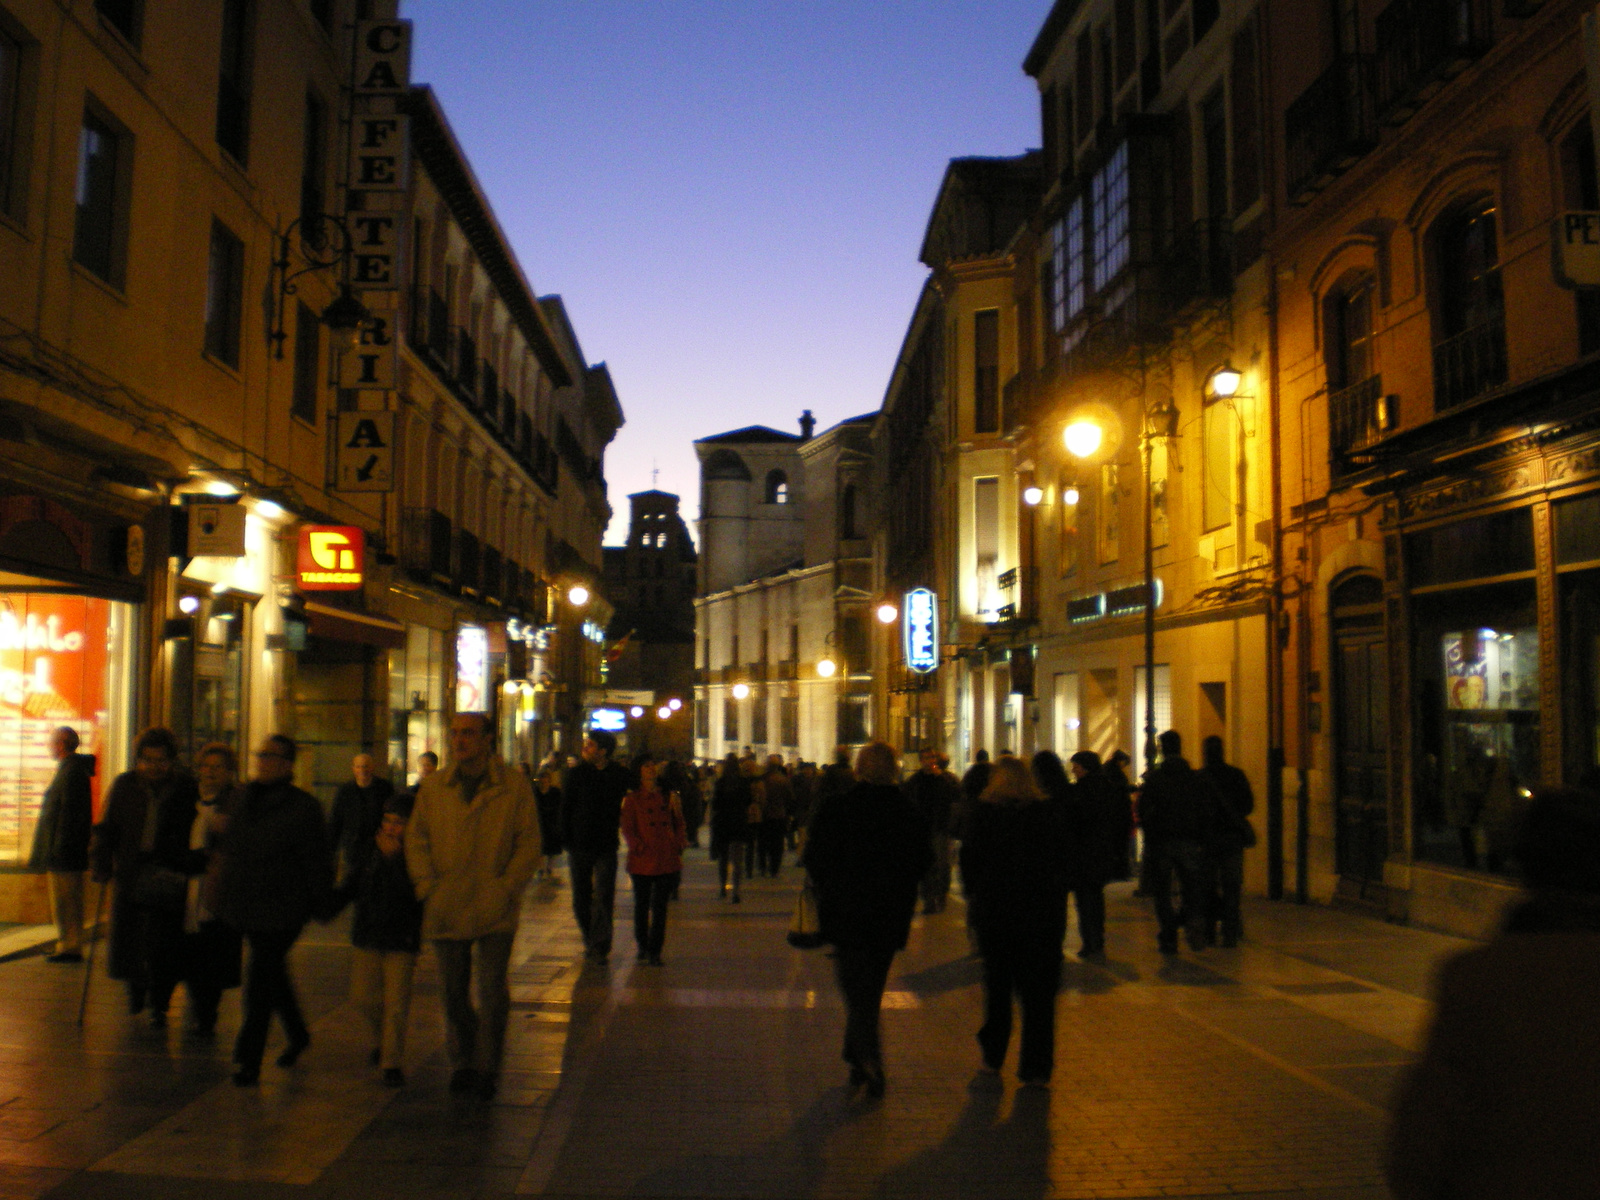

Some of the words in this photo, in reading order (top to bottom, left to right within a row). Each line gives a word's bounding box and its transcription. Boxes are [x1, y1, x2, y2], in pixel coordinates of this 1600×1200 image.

[347, 25, 400, 448] CAFETERIA
[1565, 213, 1600, 245] PE
[301, 572, 362, 583] TABACOS
[911, 593, 933, 658] HOTEL
